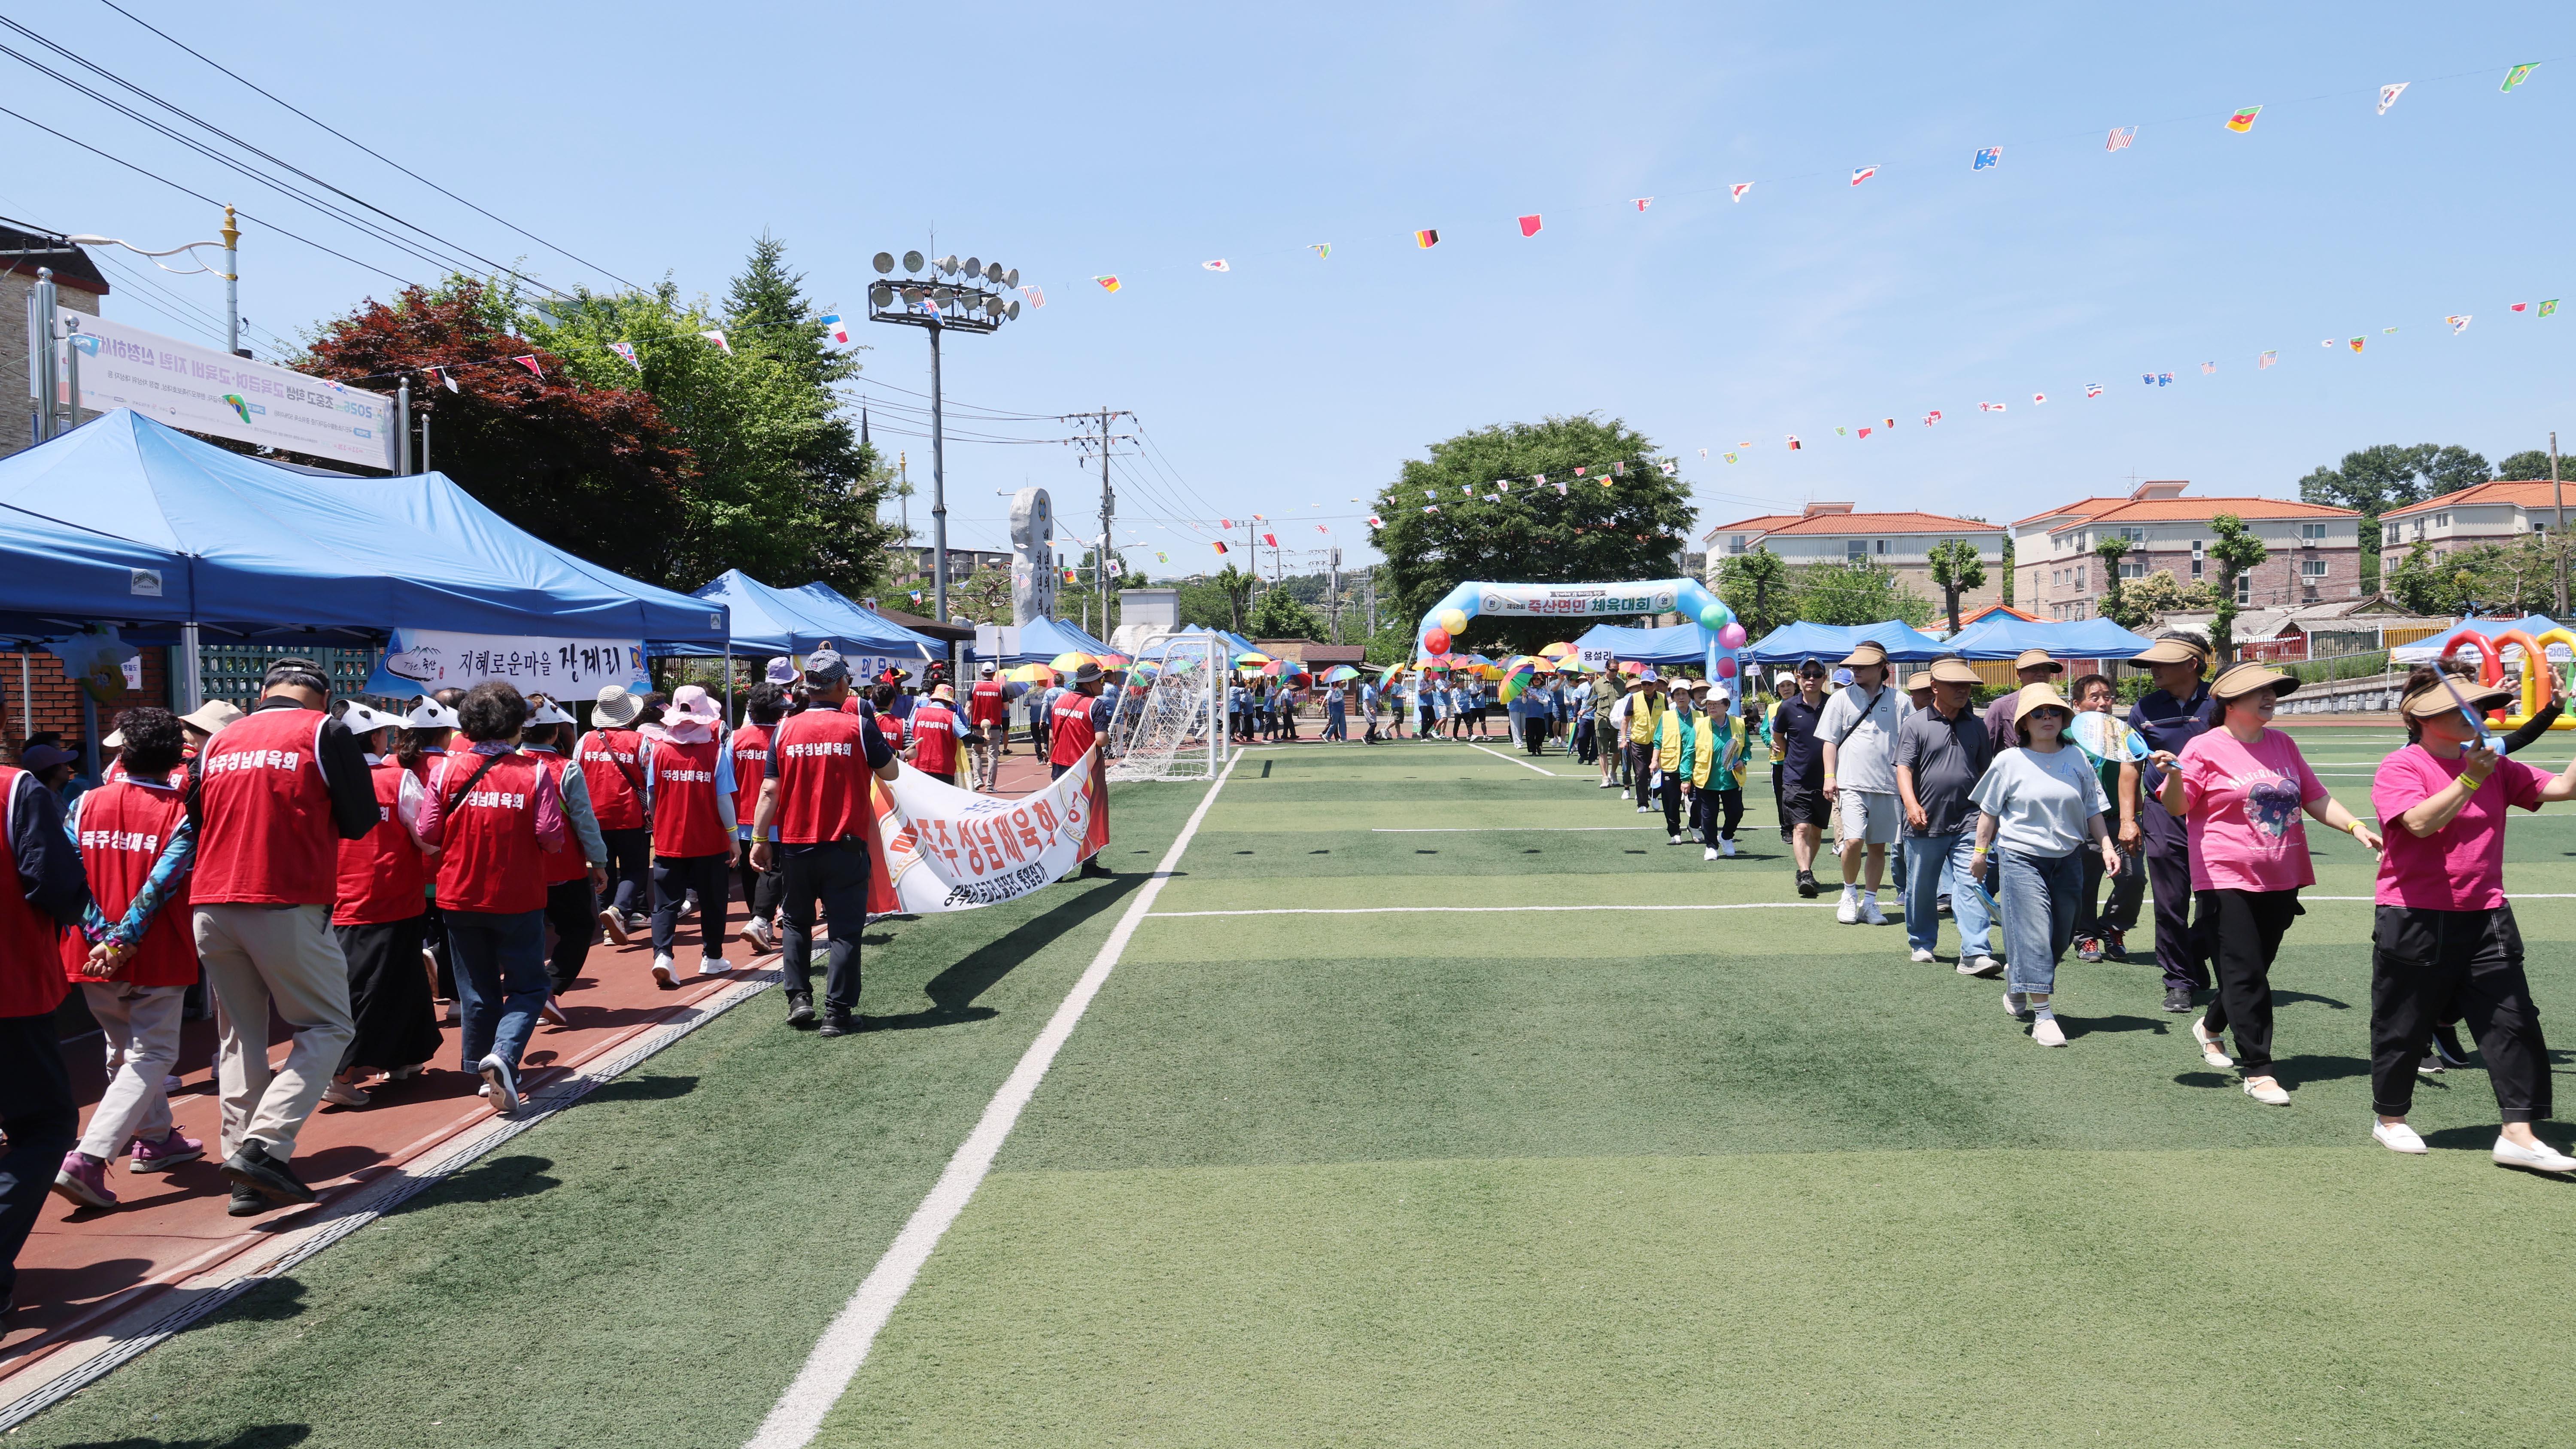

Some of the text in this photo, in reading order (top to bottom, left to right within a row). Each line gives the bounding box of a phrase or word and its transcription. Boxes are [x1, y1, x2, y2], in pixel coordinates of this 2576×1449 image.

[1528, 599, 1586, 614] 죽산면민
[1591, 597, 1650, 612] 체육대회
[559, 643, 620, 683] 장계리
[1584, 651, 1611, 661] 용설리
[422, 658, 436, 674] 죽산
[735, 750, 767, 761] 죽주성남체
[786, 742, 852, 758] 죽주성남체육회
[208, 750, 299, 774] 죽주성남체육회
[448, 791, 525, 809] 성남체육회
[81, 829, 158, 854] 죽주성남체육
